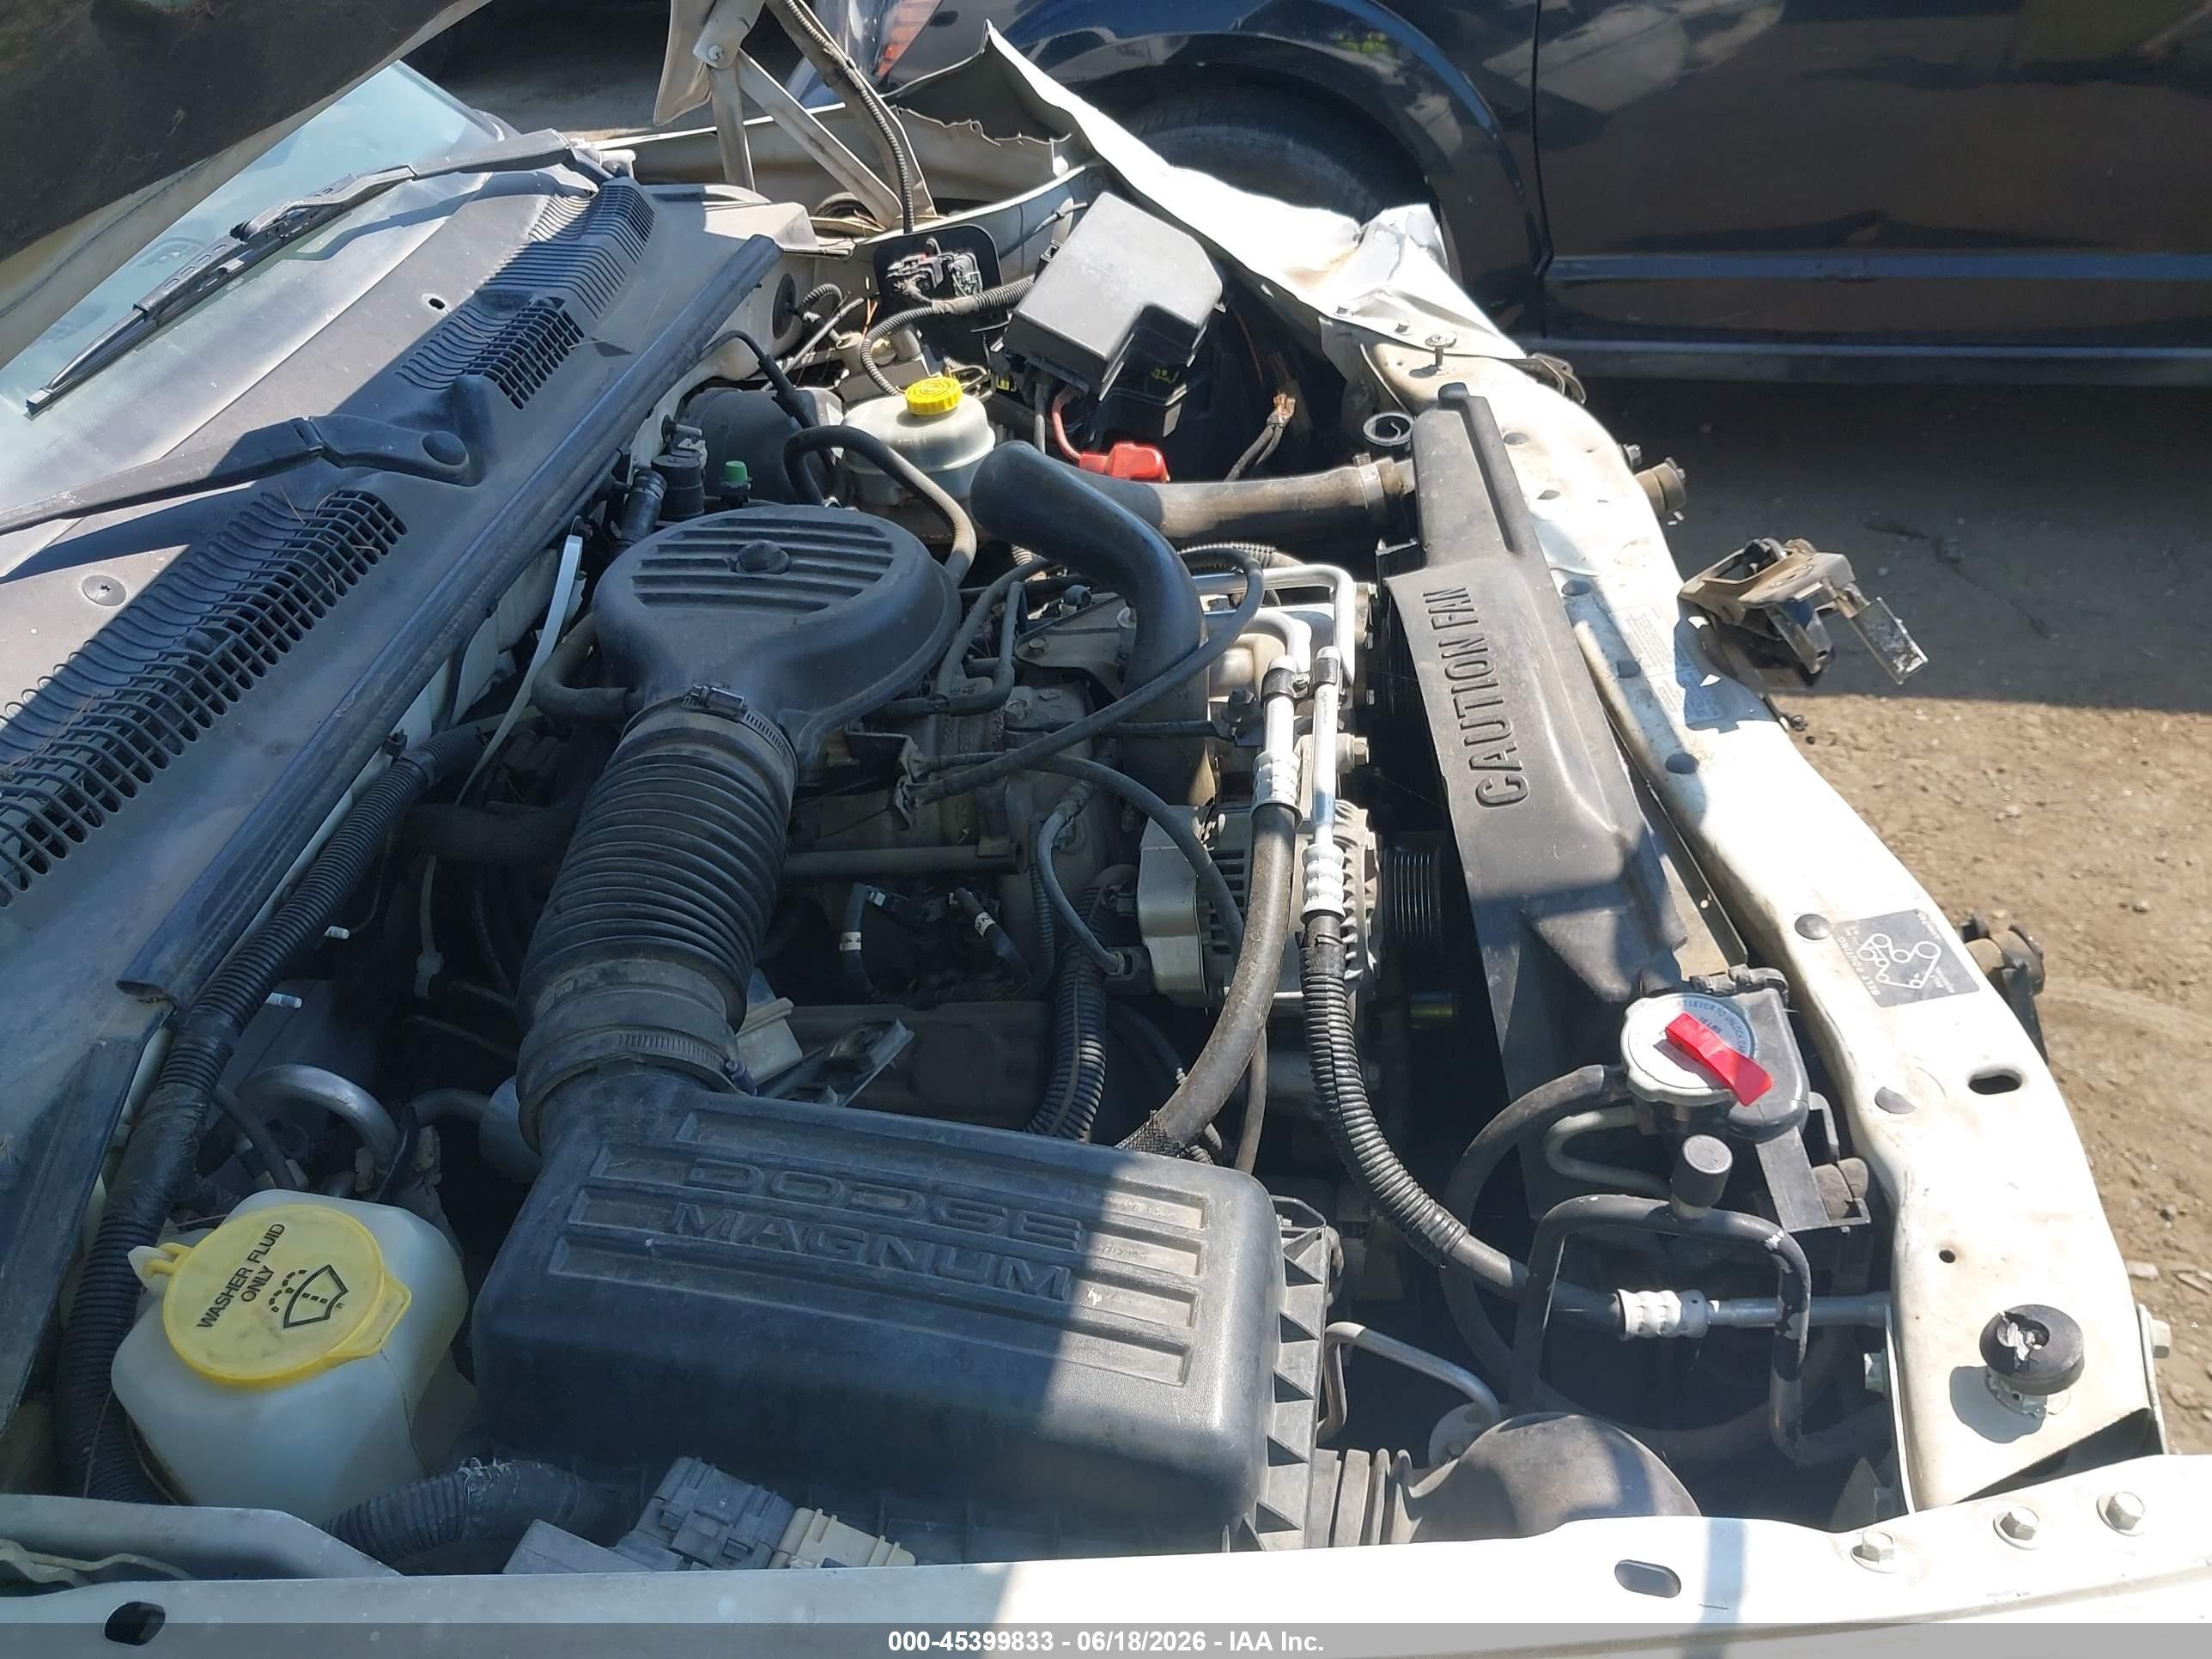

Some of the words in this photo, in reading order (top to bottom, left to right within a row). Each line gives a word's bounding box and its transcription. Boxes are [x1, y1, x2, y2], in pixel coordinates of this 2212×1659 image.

[1423, 587, 1479, 629] FAN
[1438, 633, 1529, 808] CAUTION
[1688, 1000, 1716, 1011] LEVER
[687, 1157, 1085, 1251] DODGE
[196, 1267, 254, 1328] WASHER
[247, 1224, 285, 1263] FLUID
[241, 1265, 275, 1302] ONLY
[672, 1202, 1072, 1302] MAGNUM
